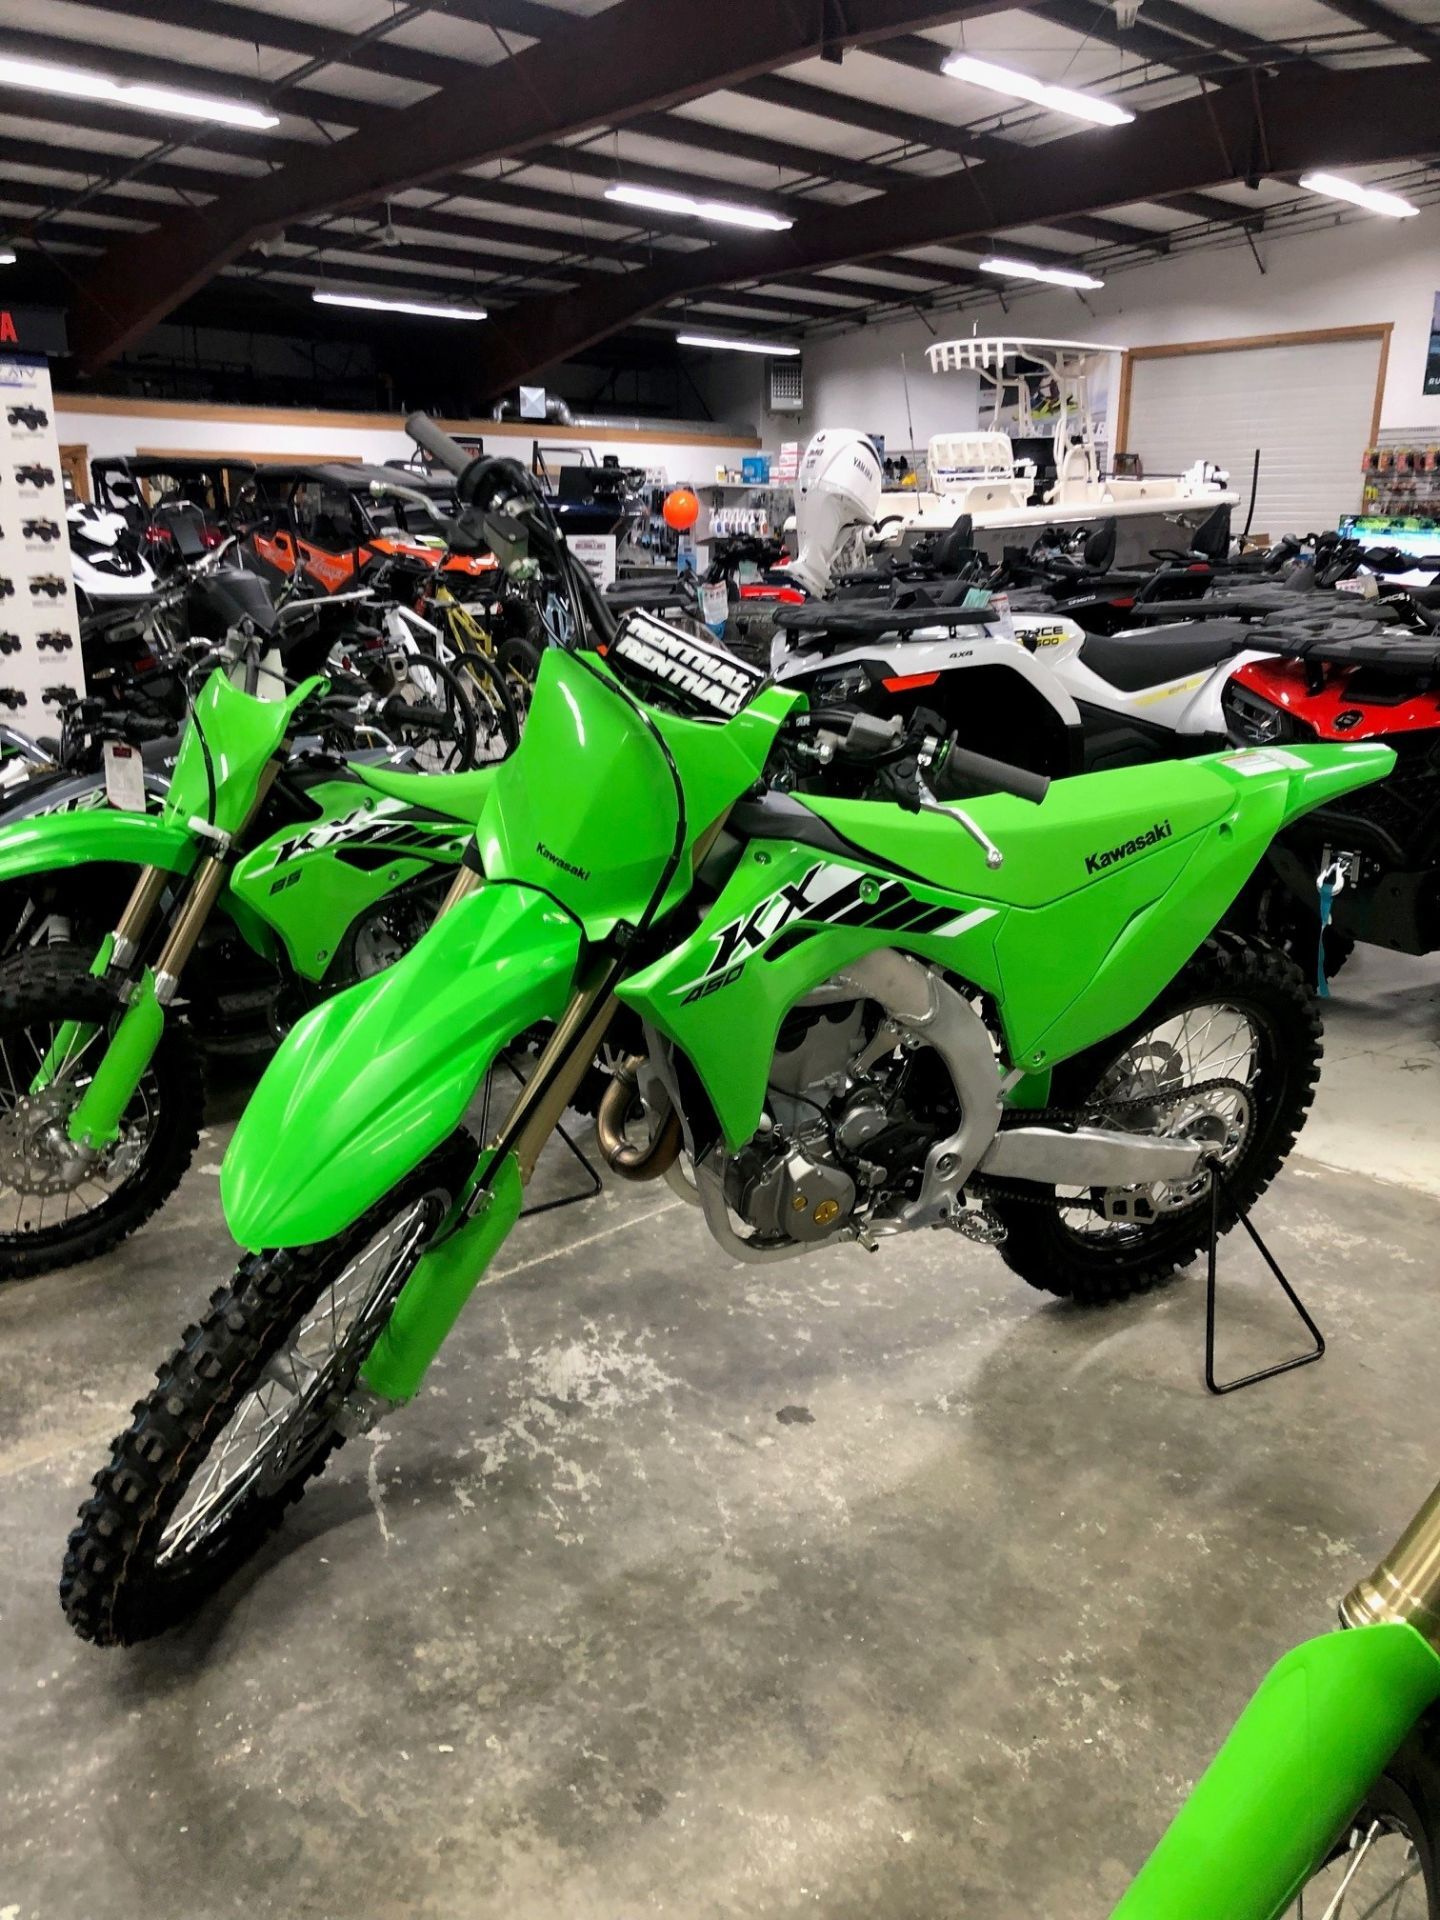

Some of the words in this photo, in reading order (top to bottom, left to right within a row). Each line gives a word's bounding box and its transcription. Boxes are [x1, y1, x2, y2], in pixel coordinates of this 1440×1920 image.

[616, 634, 745, 716] RENTHAL
[626, 617, 753, 693] RENTHAL
[536, 841, 591, 881] Kawasaki
[1084, 819, 1172, 875] Kawasaki
[706, 862, 824, 977] KX
[680, 962, 746, 1007] 450
